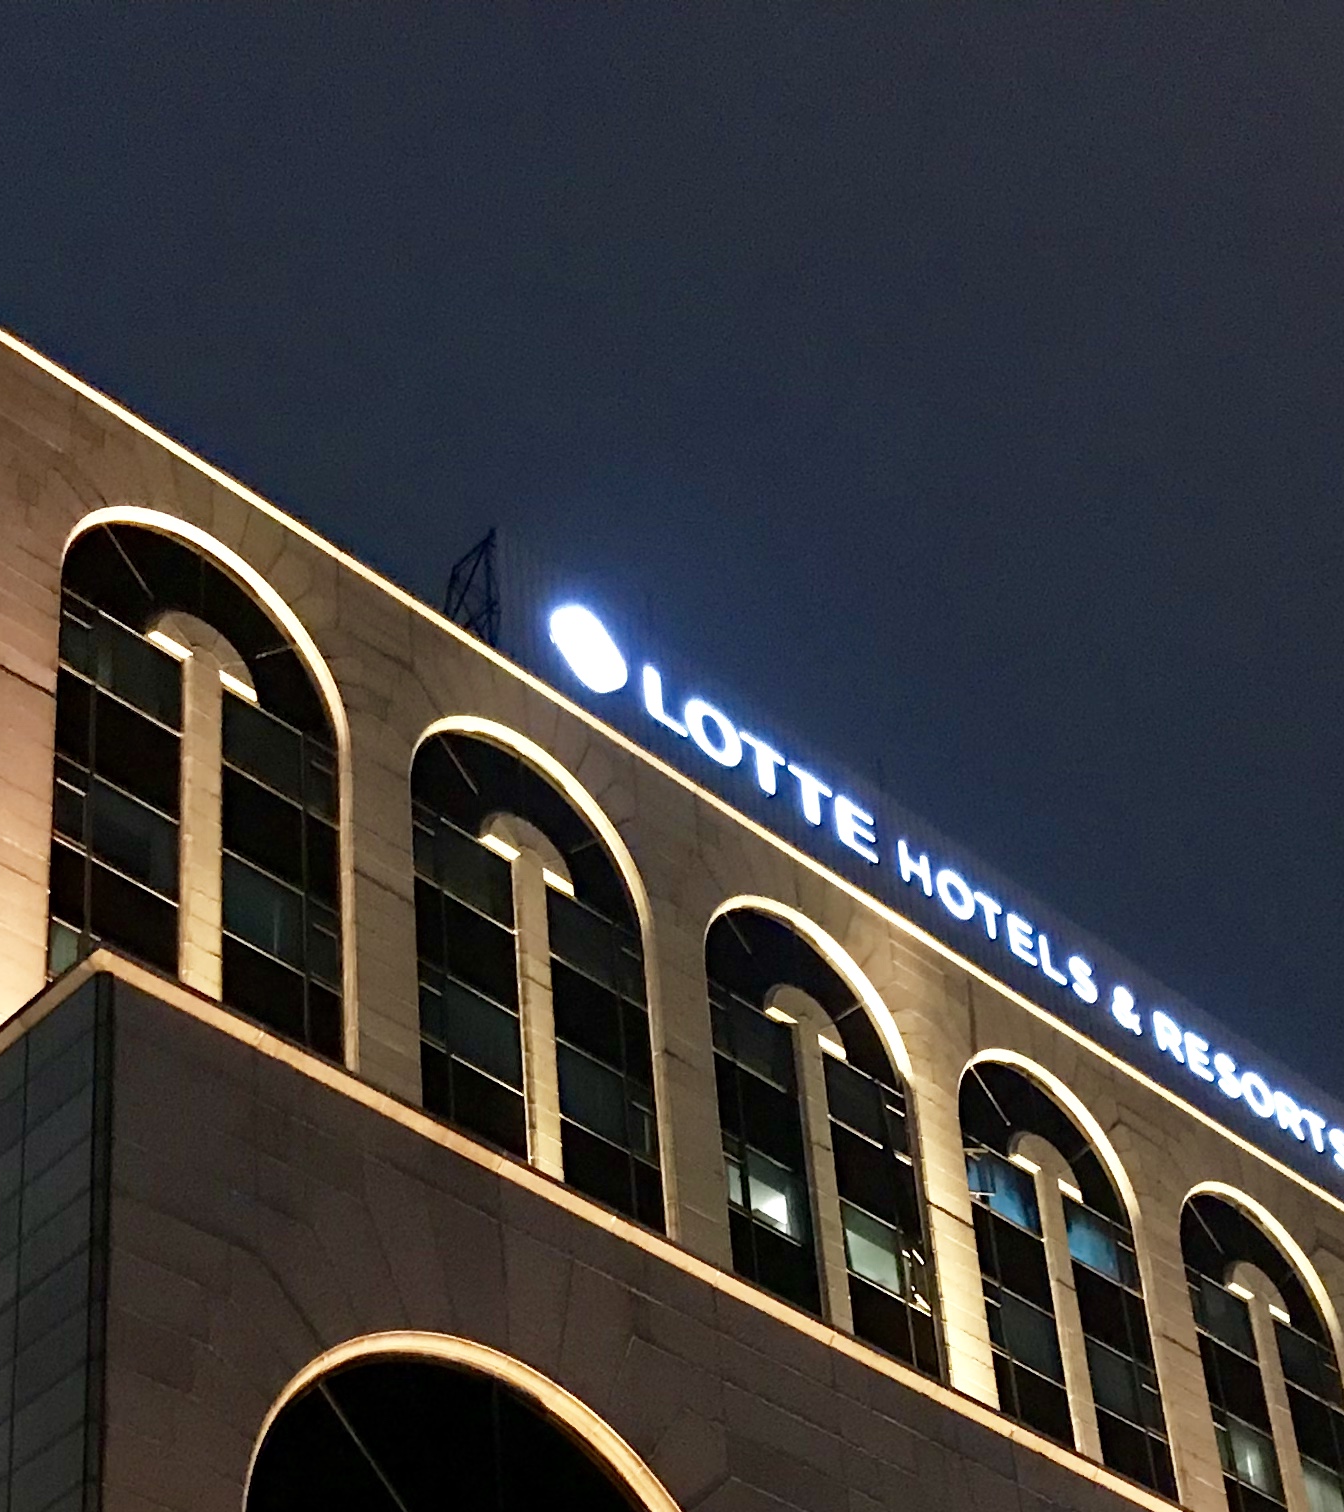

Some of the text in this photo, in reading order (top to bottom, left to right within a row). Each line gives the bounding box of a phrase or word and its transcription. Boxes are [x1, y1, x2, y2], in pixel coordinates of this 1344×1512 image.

[641, 663, 880, 866] LOTTE
[896, 838, 1099, 1005] HOTELS
[1110, 984, 1144, 1038] &
